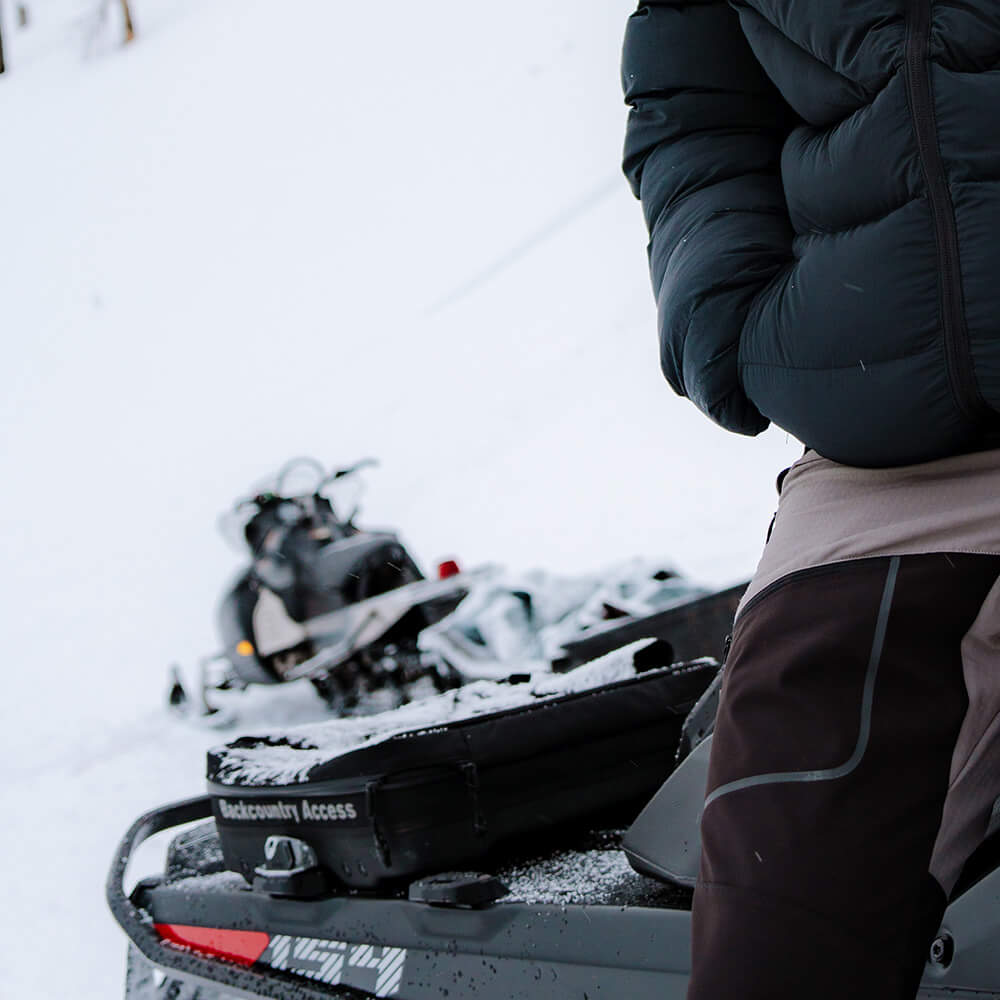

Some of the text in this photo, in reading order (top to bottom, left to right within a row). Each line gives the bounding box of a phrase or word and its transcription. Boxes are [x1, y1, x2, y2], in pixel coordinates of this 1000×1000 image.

[218, 799, 357, 824] Backcountry Access
[268, 934, 406, 997] 154
